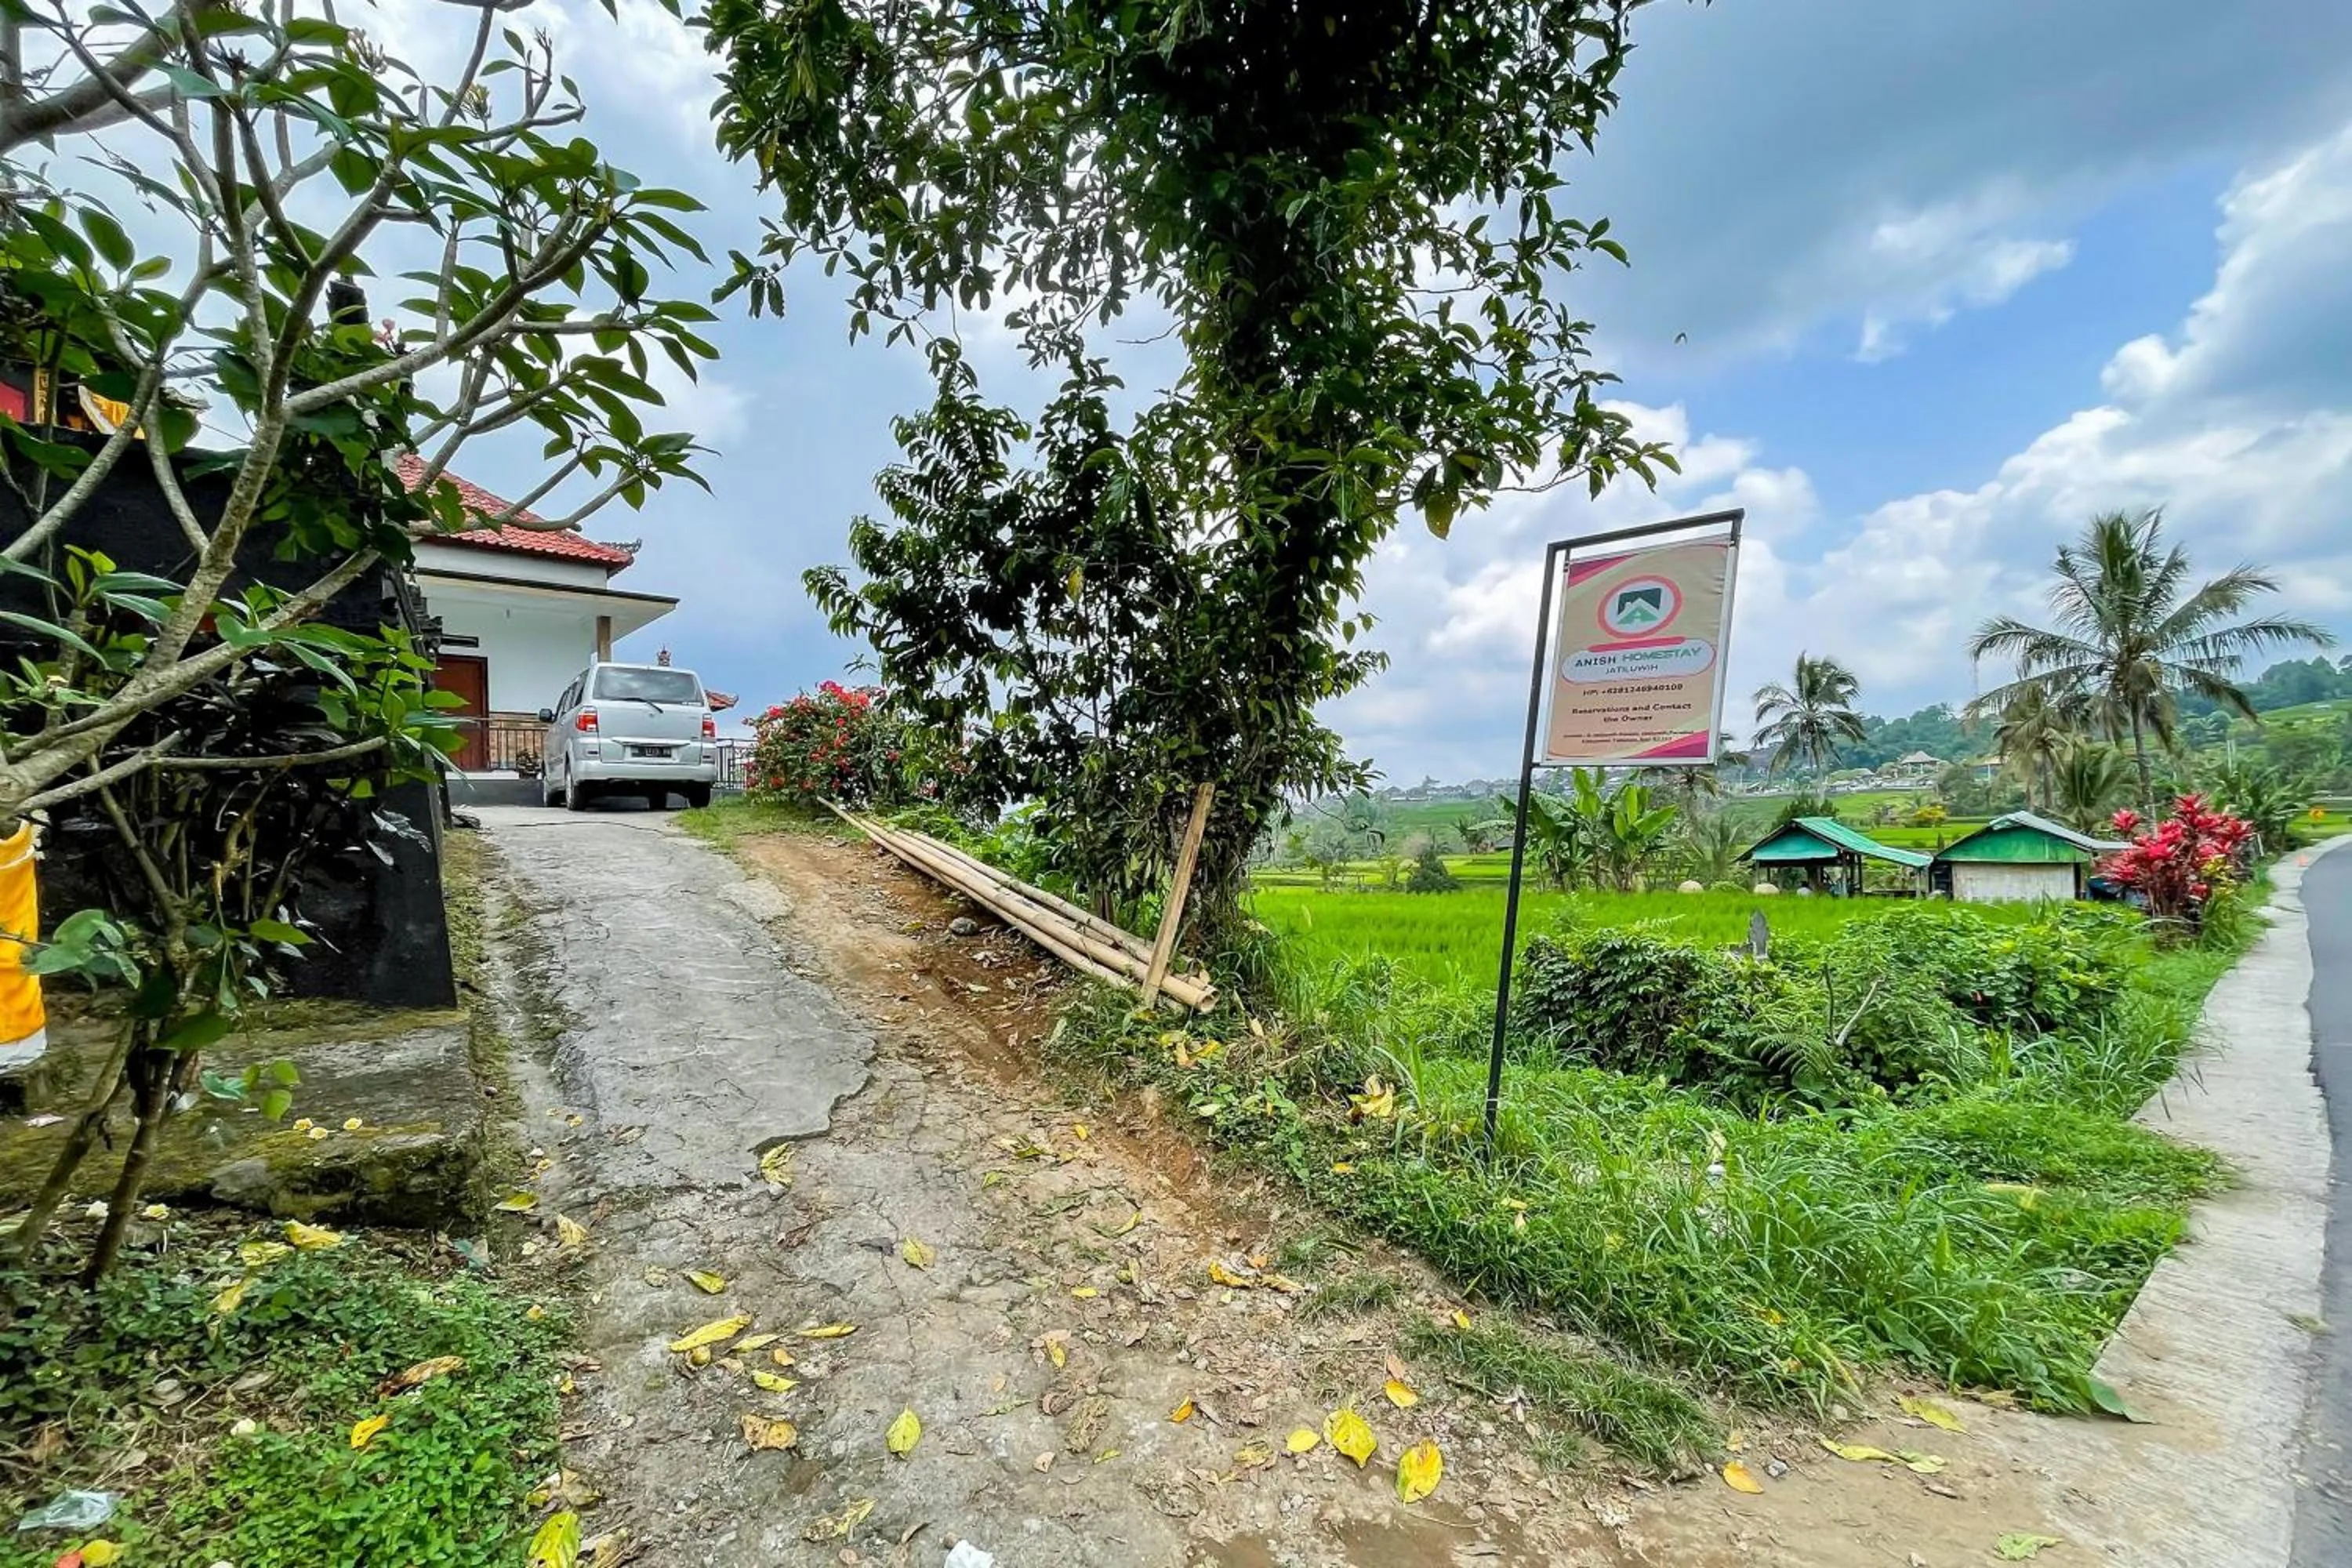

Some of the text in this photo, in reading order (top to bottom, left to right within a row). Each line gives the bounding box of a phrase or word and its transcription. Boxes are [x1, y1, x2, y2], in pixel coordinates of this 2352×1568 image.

[1575, 647, 1703, 667] ANISH HOMESTAY
[1606, 664, 1659, 674] JATILUWIH
[1572, 706, 1630, 715] Reservations
